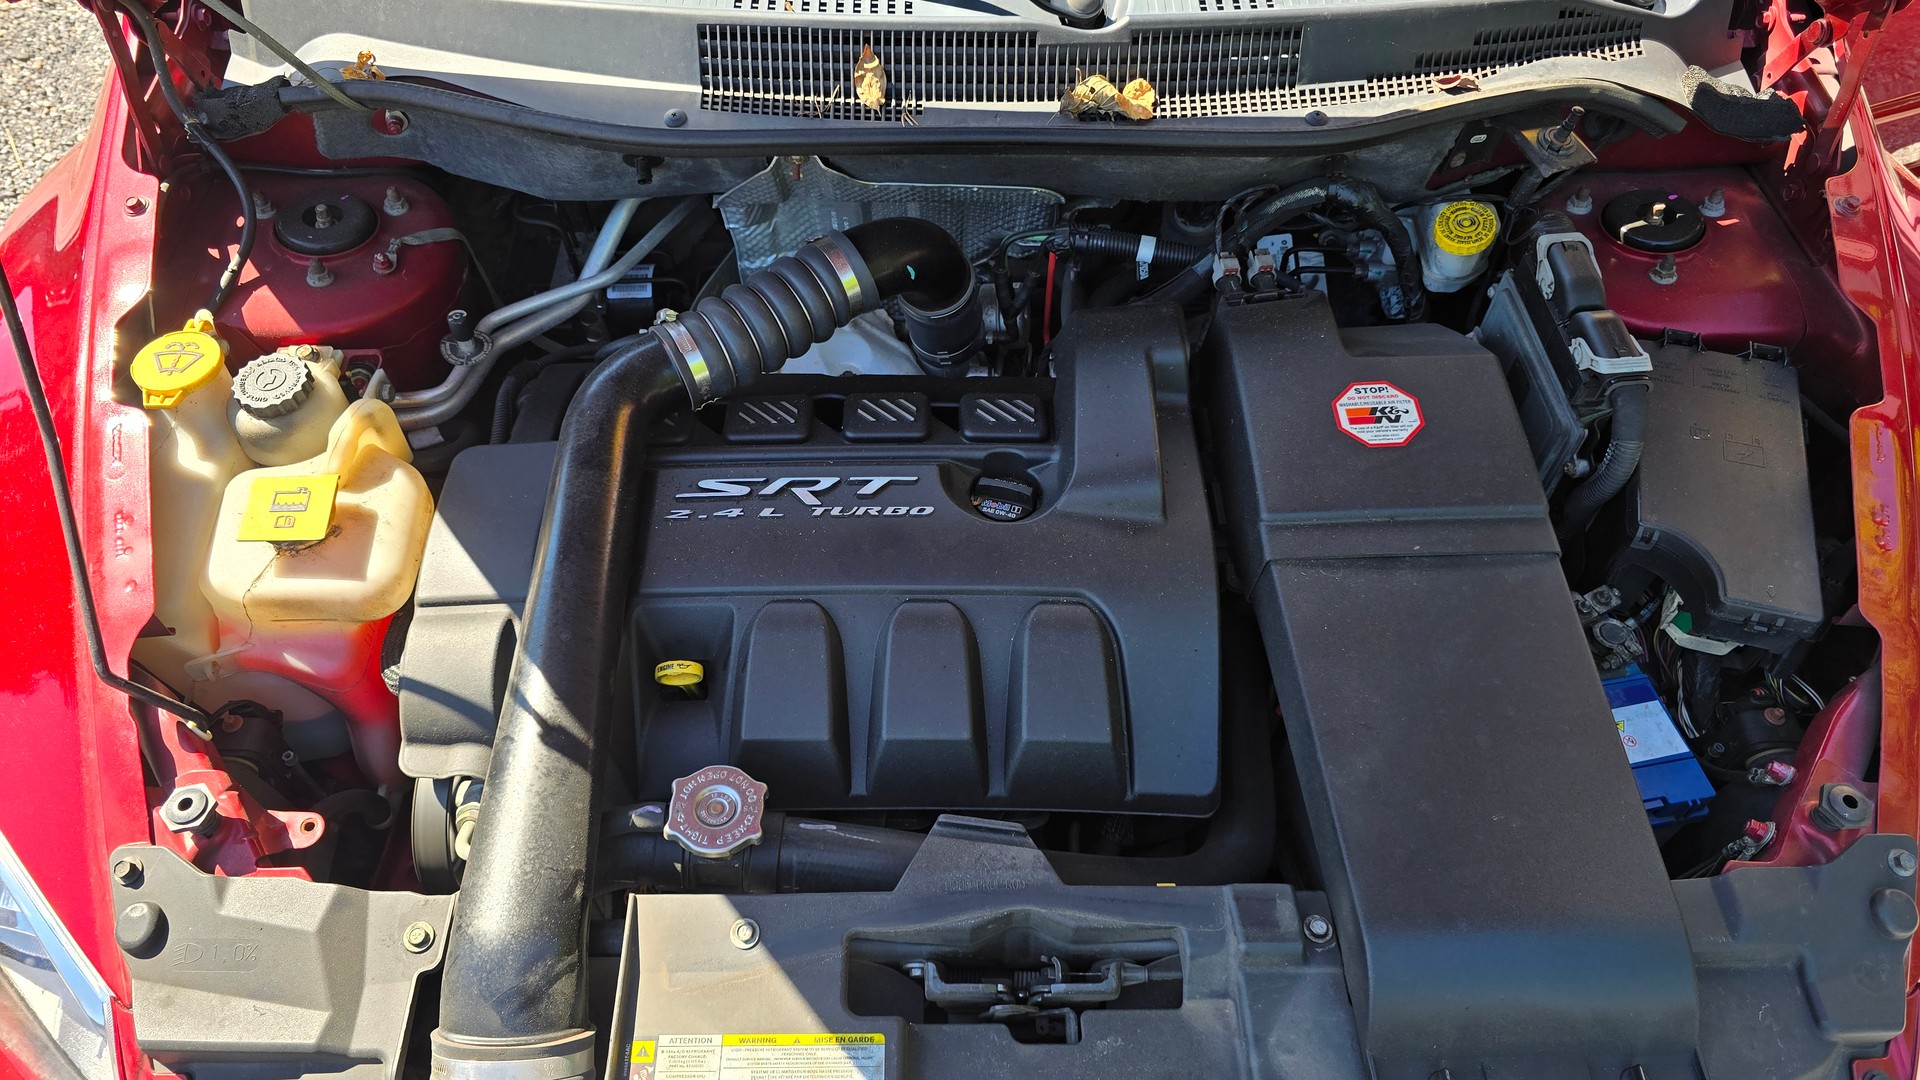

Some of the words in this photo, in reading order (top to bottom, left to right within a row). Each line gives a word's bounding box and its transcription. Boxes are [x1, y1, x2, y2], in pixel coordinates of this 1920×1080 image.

[675, 476, 919, 506] SRT
[664, 508, 745, 519] 2.4
[757, 507, 785, 517] L
[811, 506, 935, 517] TURBO
[981, 500, 1011, 512] Mobil
[679, 822, 709, 845] TIGHT
[716, 824, 747, 845] KEEP
